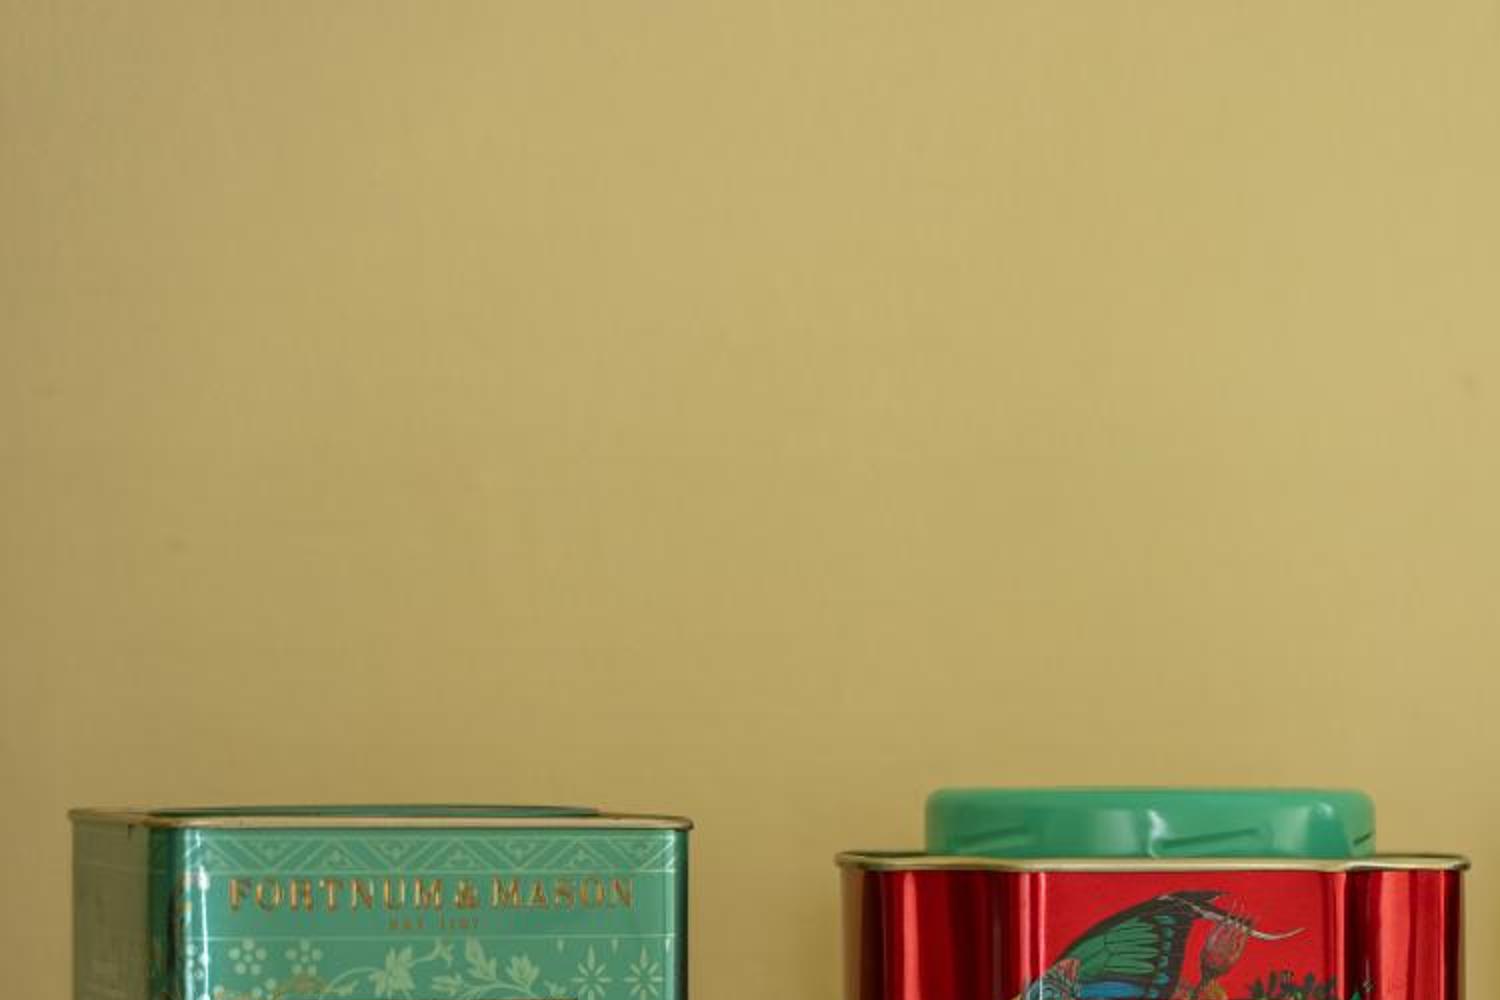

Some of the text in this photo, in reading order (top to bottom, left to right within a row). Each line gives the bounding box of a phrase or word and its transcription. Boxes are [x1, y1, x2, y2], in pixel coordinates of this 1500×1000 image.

[228, 877, 635, 912] FORTNUM & MASON
